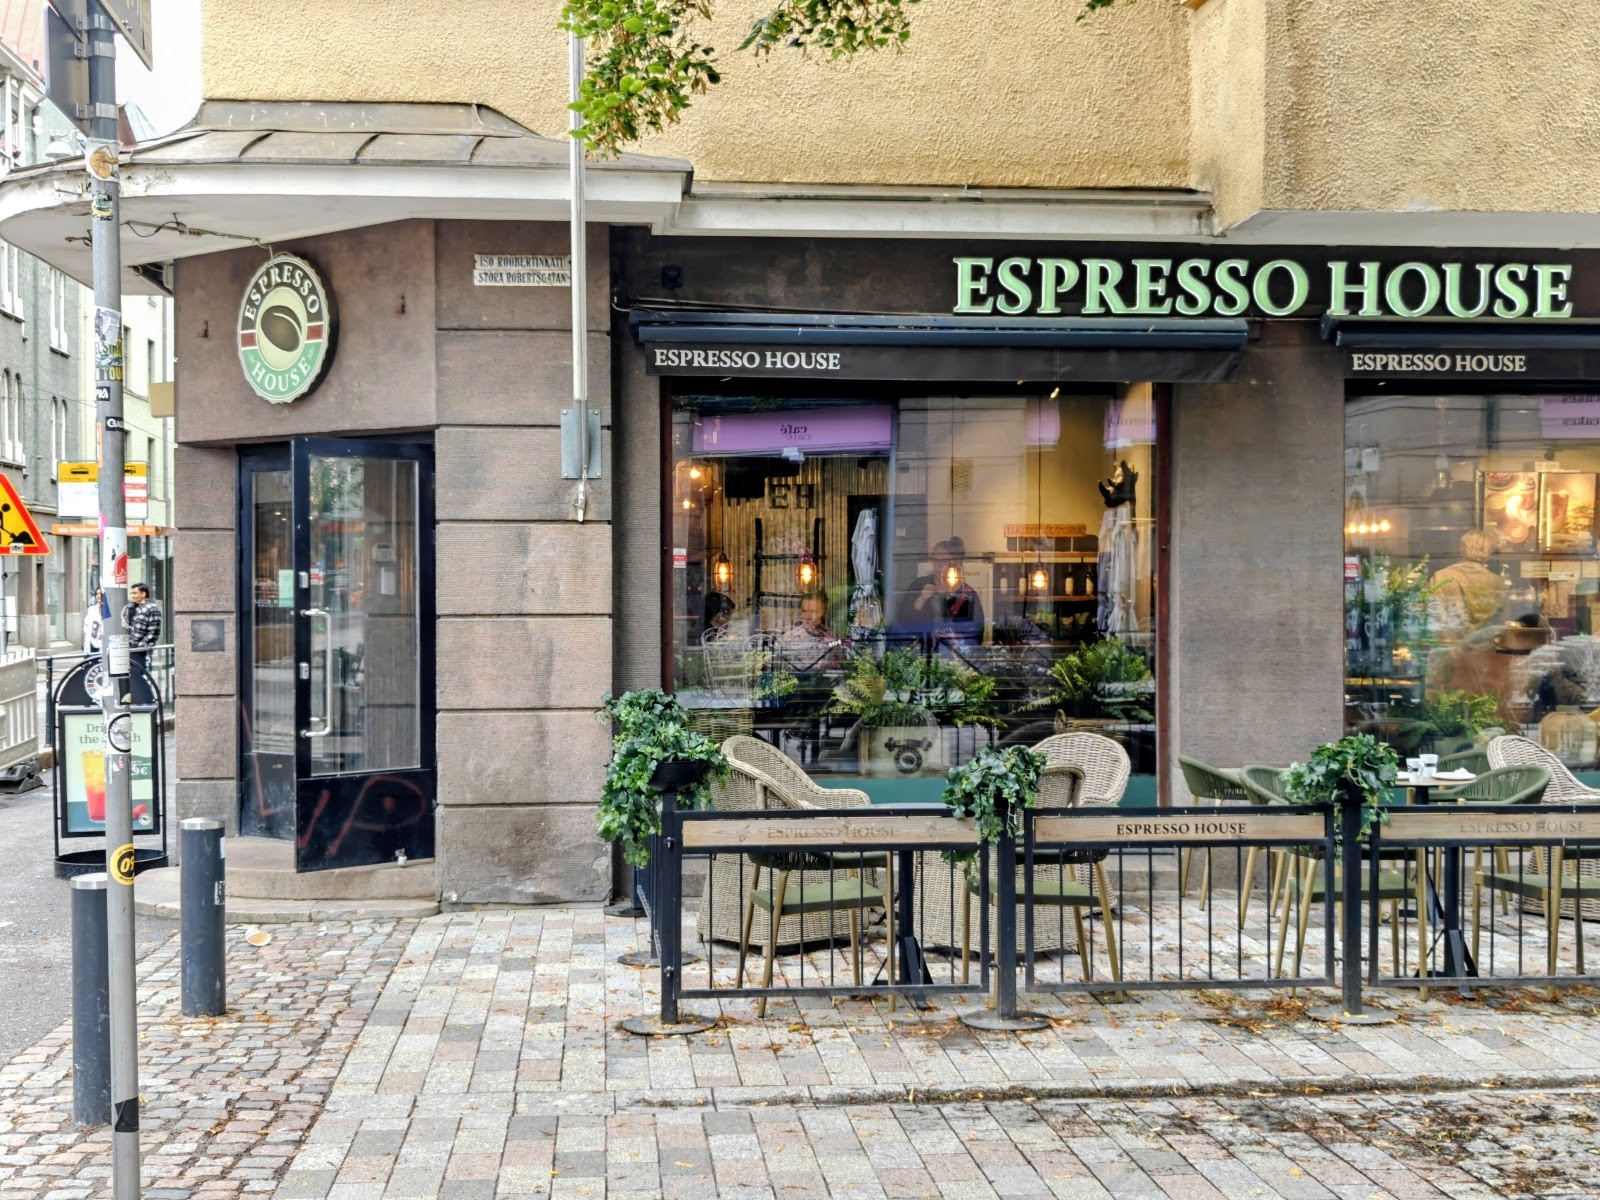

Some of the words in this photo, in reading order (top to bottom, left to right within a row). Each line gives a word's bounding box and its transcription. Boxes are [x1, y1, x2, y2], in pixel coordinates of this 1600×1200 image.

[480, 256, 494, 268] ISO
[478, 272, 504, 284] STORA
[244, 265, 320, 321] ESPRESSO
[953, 257, 1309, 316] ESPRESSO
[1327, 260, 1573, 318] HOUSE
[654, 349, 760, 368] ESPRESSO
[765, 352, 840, 370] HOUSE
[1352, 354, 1451, 371] ESPRESSO
[1455, 355, 1526, 372] HOUSE
[252, 357, 311, 391] HOUSE
[80, 734, 99, 744] the
[768, 826, 839, 838] ESPRESSO
[1116, 823, 1190, 835] ESPRESSO
[1194, 823, 1246, 834] HOUSE
